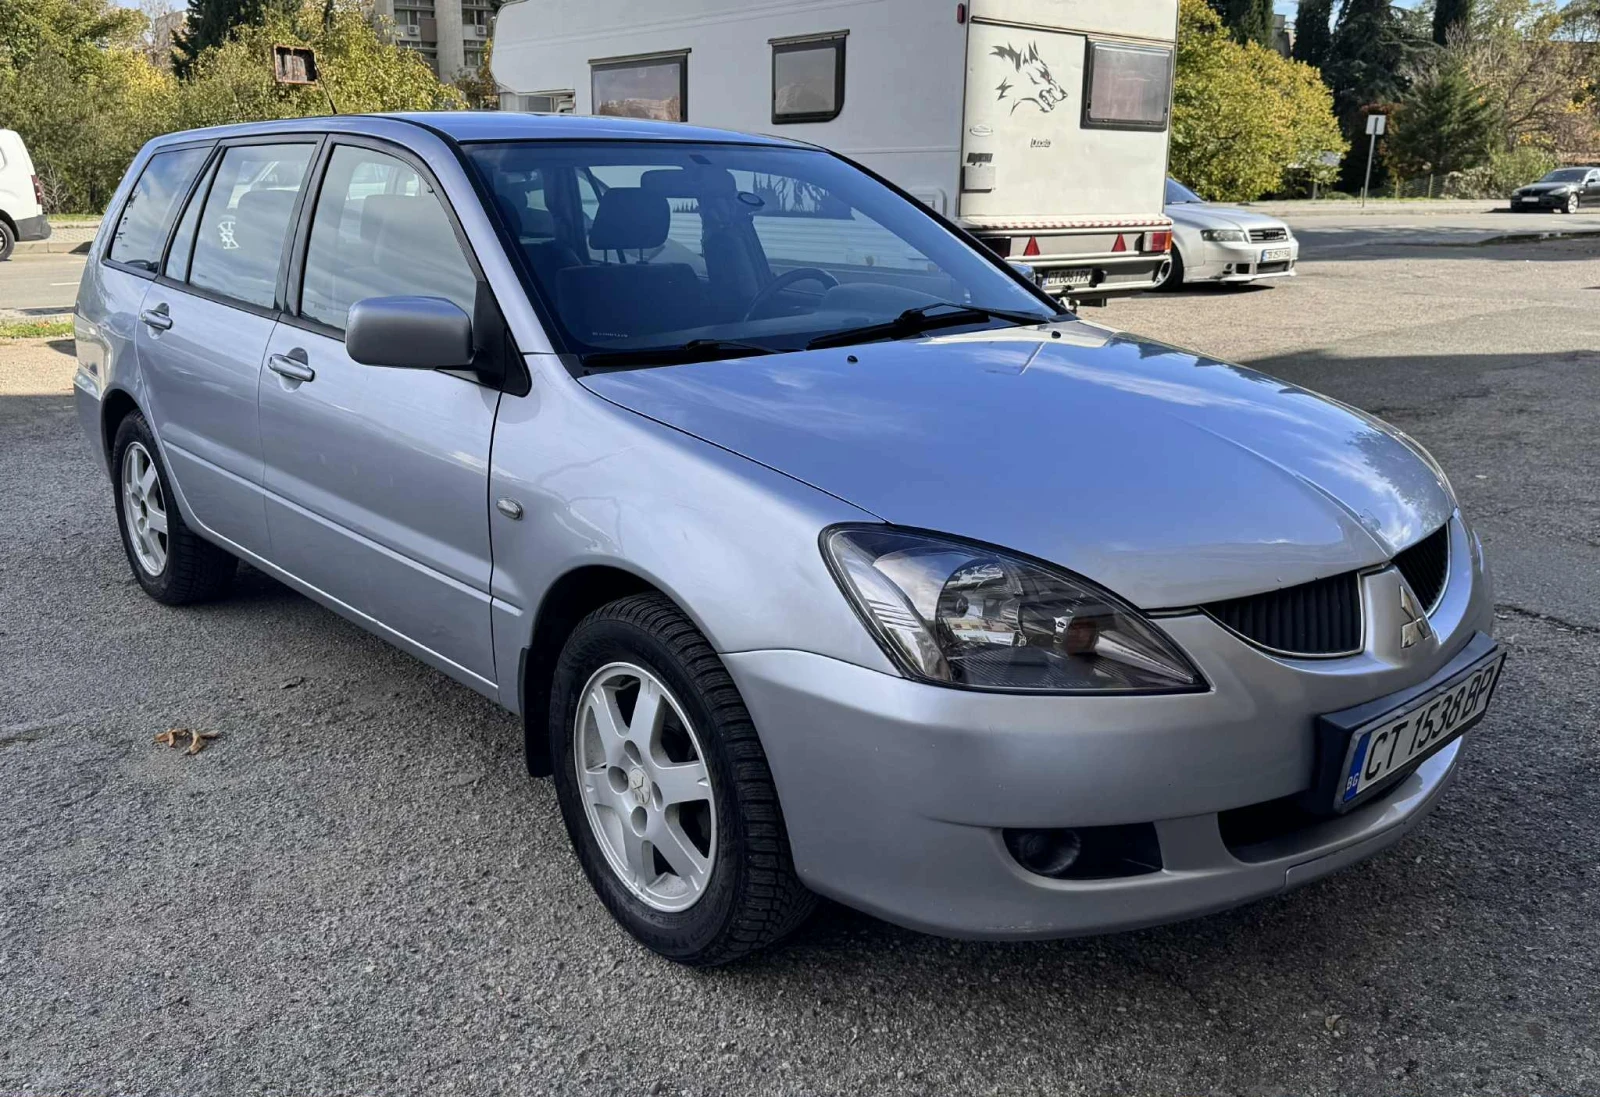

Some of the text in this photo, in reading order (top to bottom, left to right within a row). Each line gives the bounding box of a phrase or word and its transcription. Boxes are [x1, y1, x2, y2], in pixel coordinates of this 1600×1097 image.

[1365, 665, 1495, 780] CT 1538 BP
[1346, 772, 1359, 791] BG
